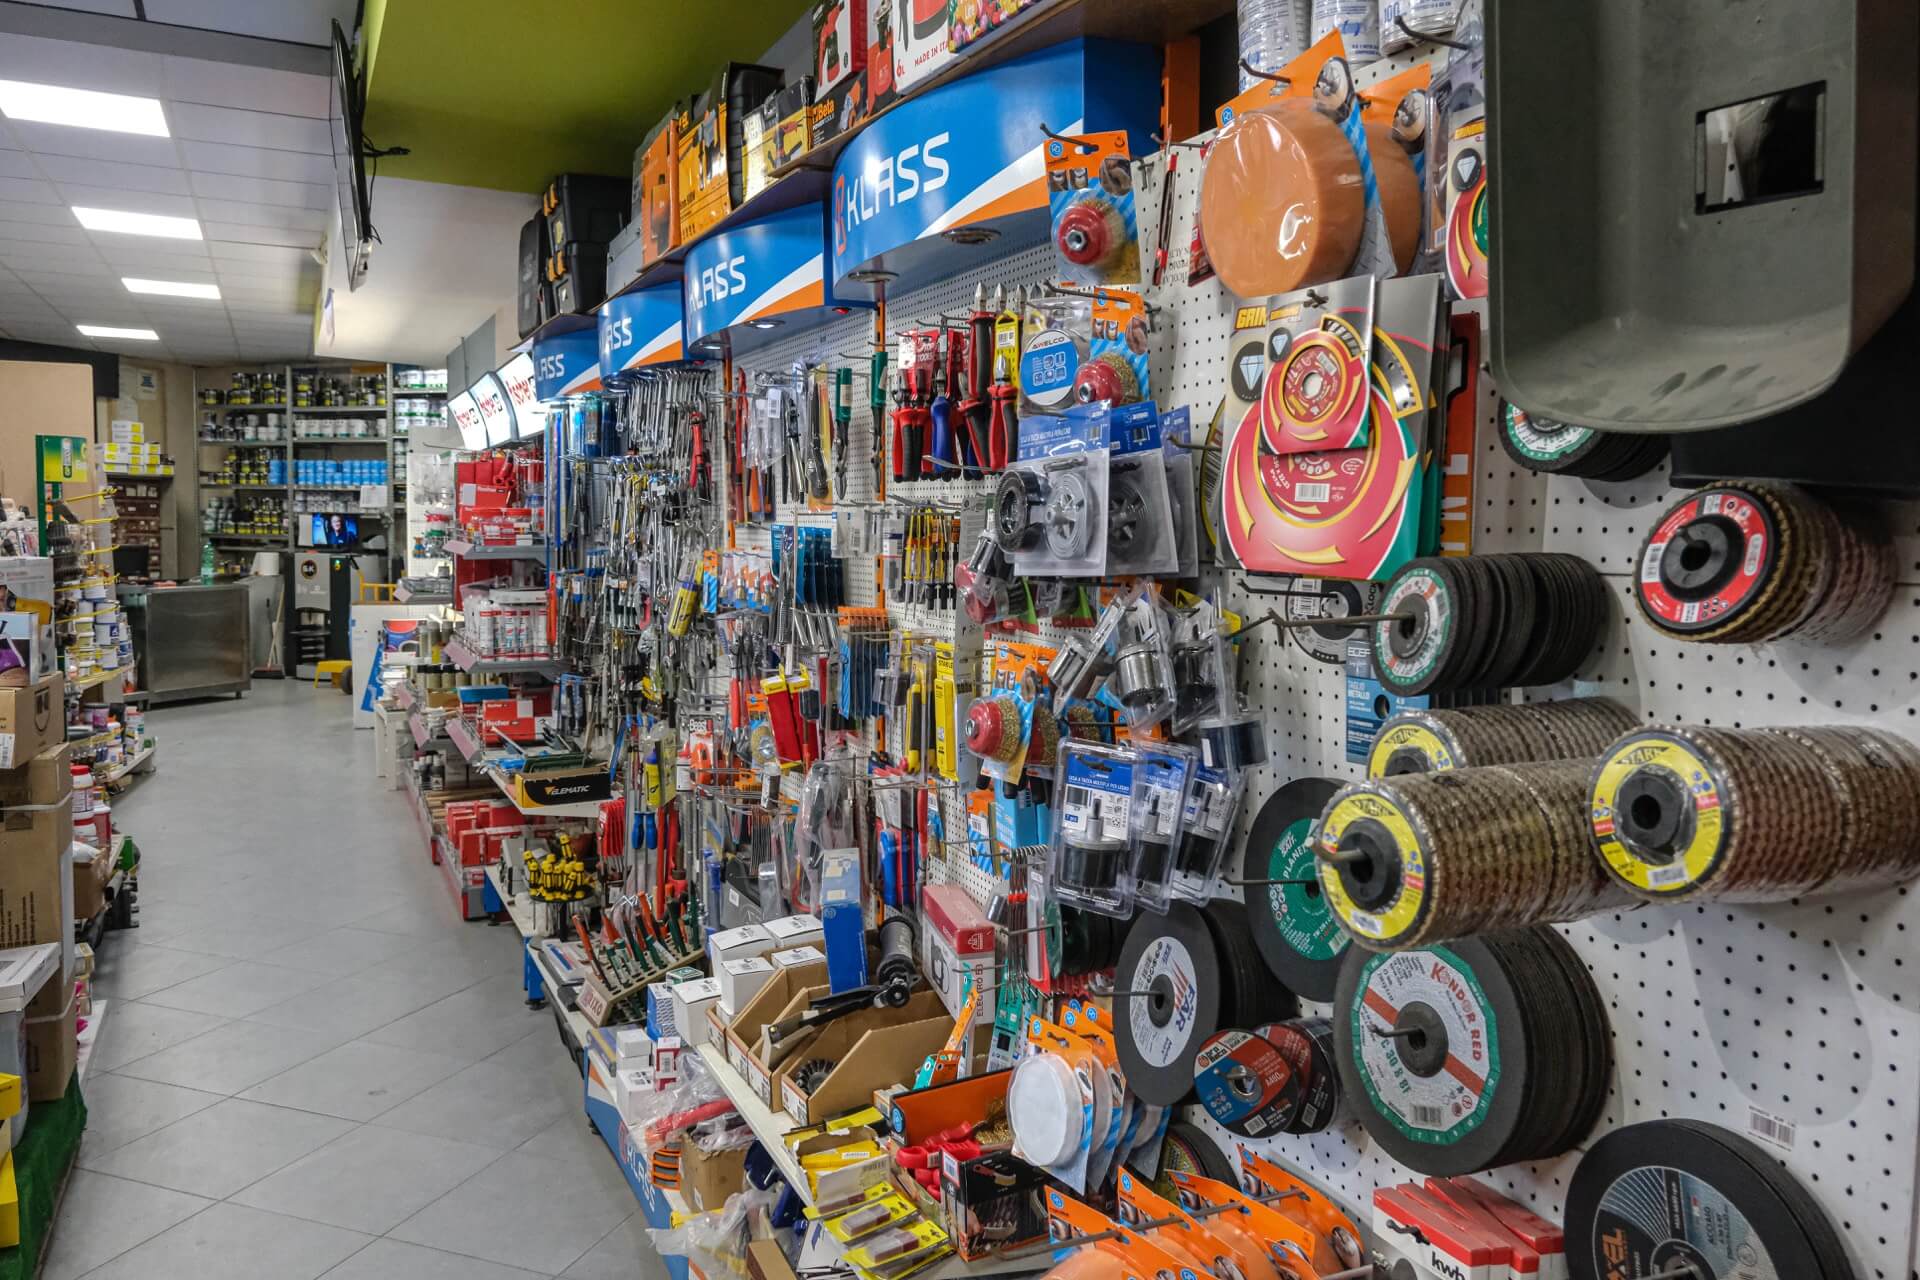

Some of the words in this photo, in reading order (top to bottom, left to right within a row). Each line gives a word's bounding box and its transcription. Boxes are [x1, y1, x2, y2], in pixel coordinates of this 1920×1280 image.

[914, 53, 931, 67] MADE
[931, 46, 939, 58] IN
[817, 98, 835, 118] Beta
[1235, 306, 1267, 330] GRIN
[1032, 336, 1065, 349] AWELCO
[485, 719, 510, 729] fischer
[1430, 962, 1477, 1024] KONDOR
[1470, 1029, 1483, 1062] RED
[1431, 1251, 1466, 1280] kwb
